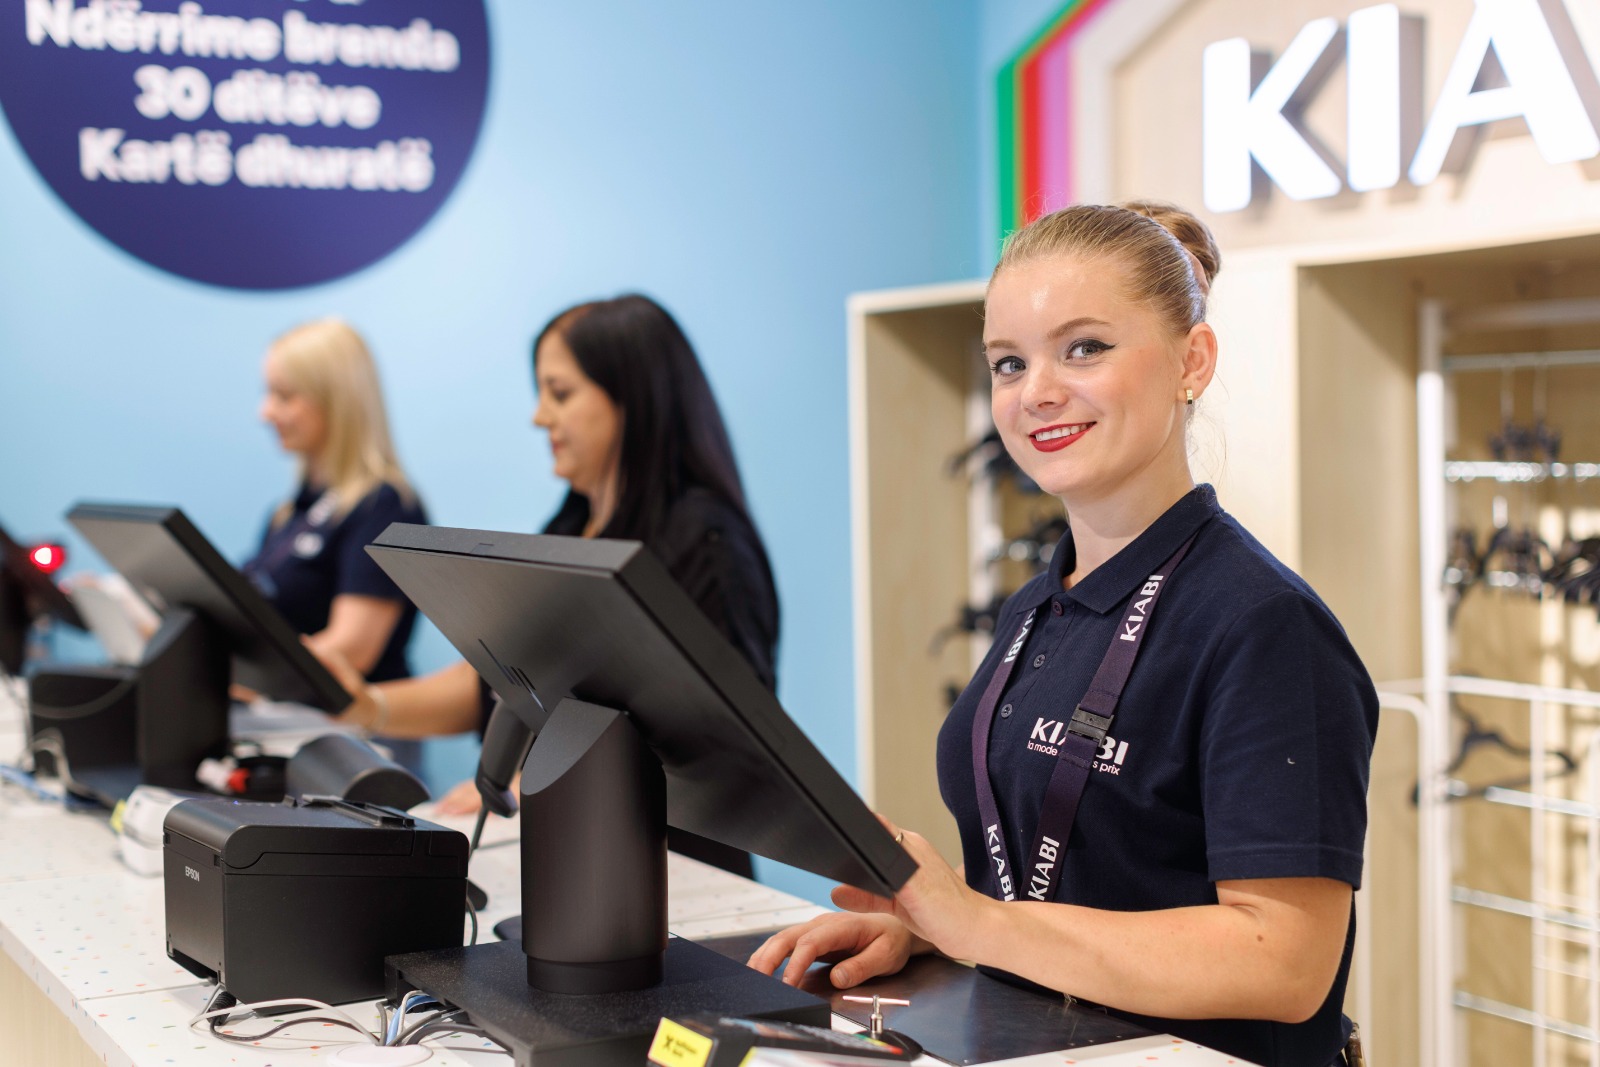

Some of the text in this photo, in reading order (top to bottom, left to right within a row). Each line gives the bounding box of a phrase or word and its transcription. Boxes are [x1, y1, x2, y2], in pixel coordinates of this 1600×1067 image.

[283, 9, 460, 72] brenda
[134, 65, 211, 120] 30
[1202, 0, 1600, 213] KIA
[79, 127, 434, 192] Kartë dhuratë
[1120, 574, 1164, 642] KIABI
[1030, 717, 1129, 766] KIBI
[1034, 743, 1058, 756] mode
[1099, 763, 1121, 776] prix
[185, 865, 200, 882] EPSON
[987, 823, 1015, 902] KIABI
[1027, 835, 1060, 901] KIABI
